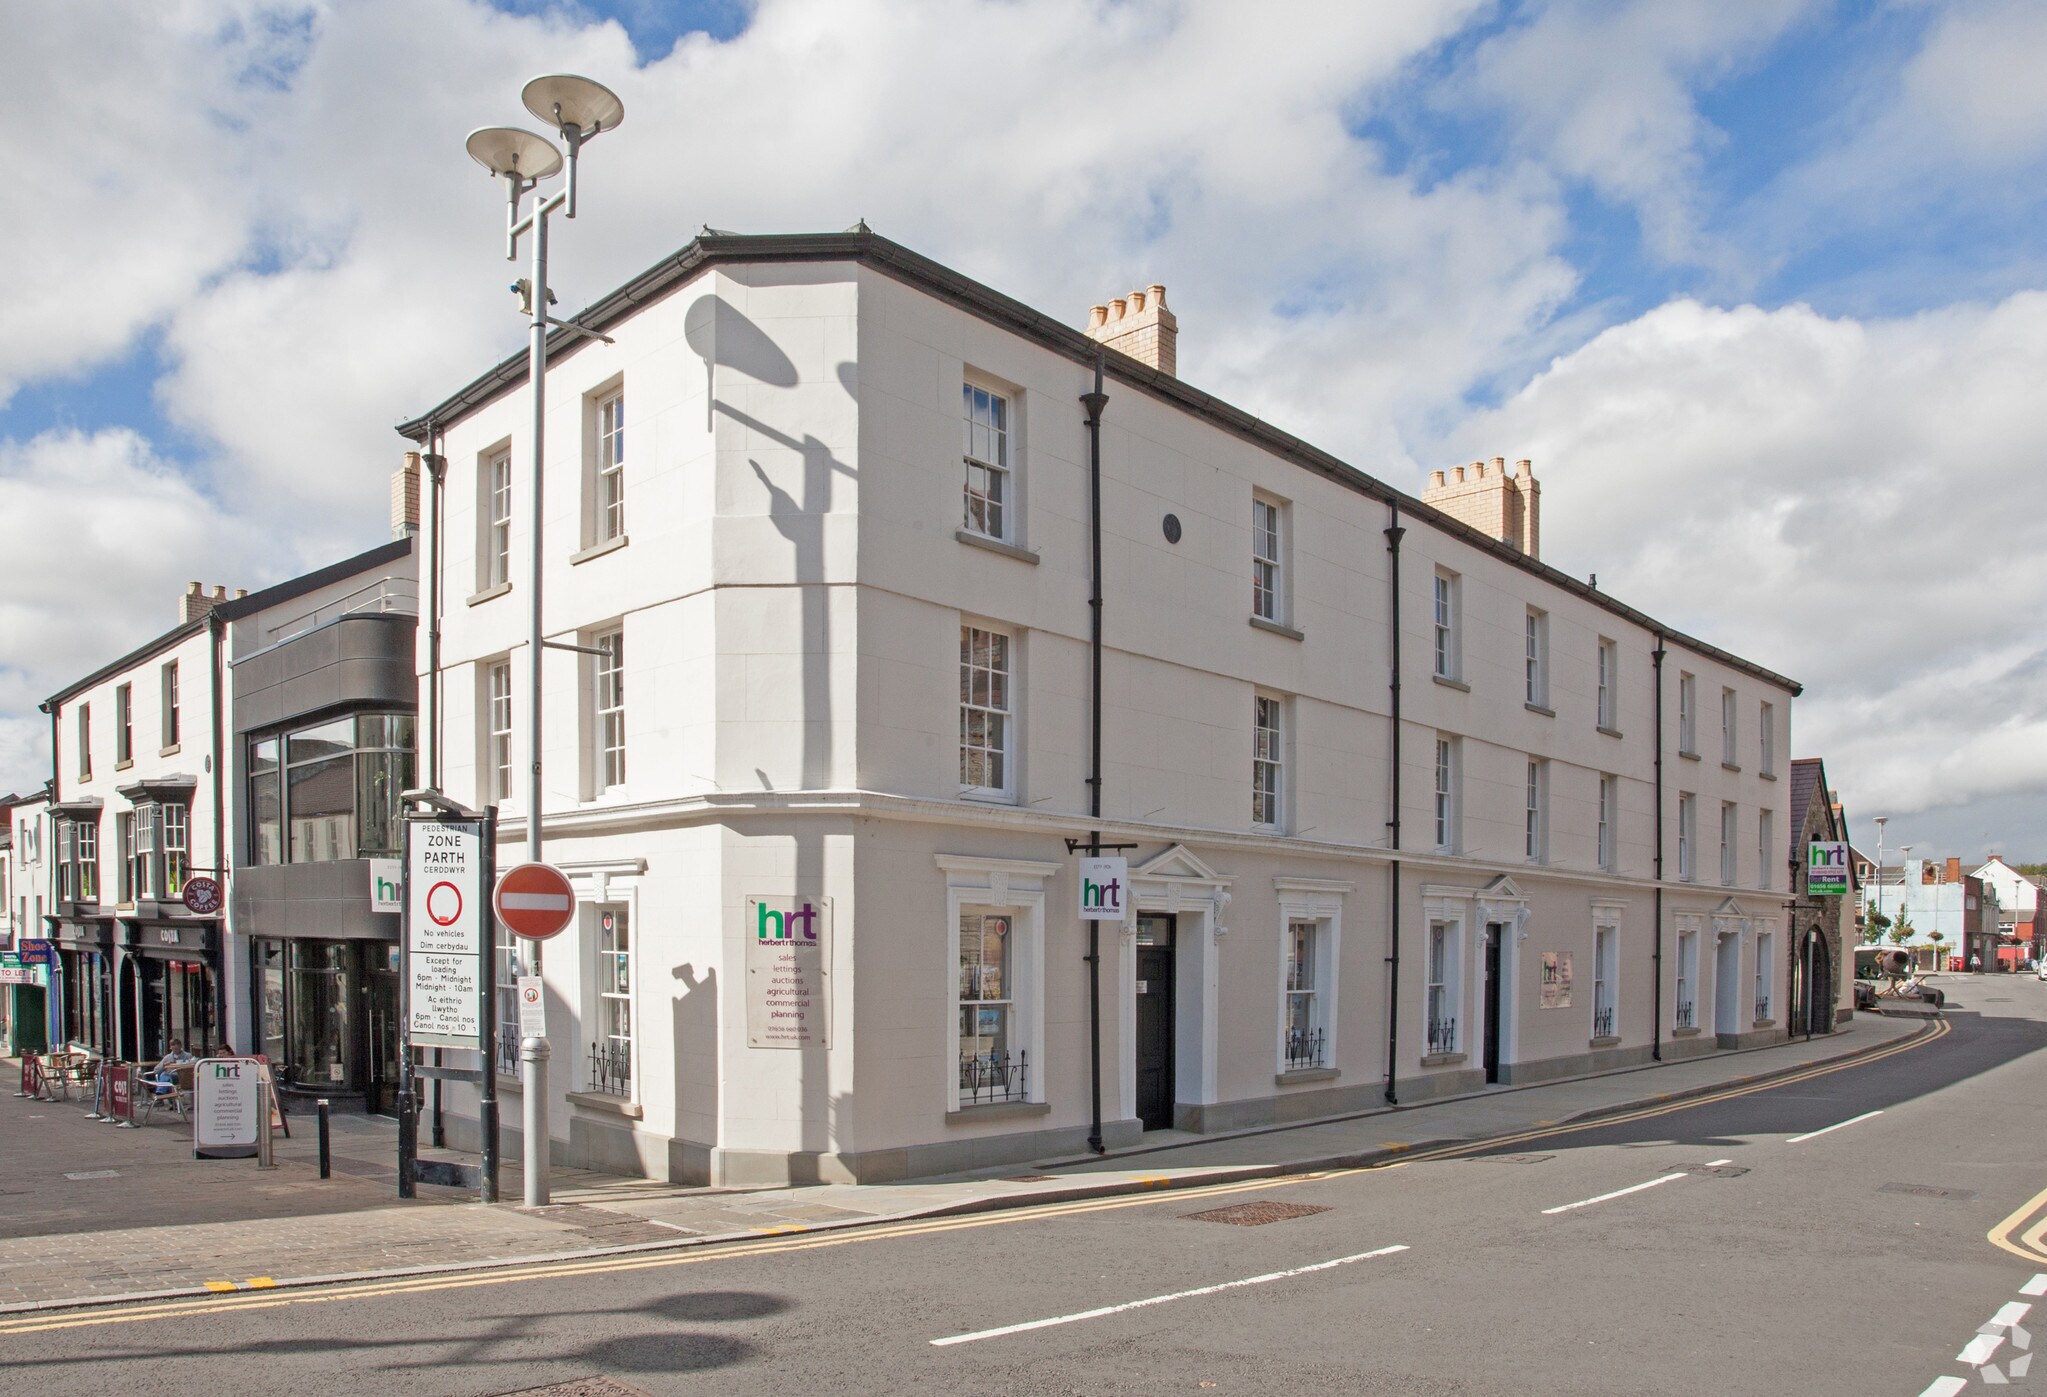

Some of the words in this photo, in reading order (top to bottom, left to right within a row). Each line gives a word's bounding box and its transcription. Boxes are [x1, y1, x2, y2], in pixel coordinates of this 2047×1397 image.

[428, 835, 461, 847] ZONE
[424, 852, 465, 864] PARTH
[1812, 845, 1844, 865] hrt
[424, 866, 465, 874] CERDDWYR
[191, 881, 214, 891] COSTA
[1084, 878, 1120, 907] hrt
[190, 898, 218, 910] COFFEE
[758, 903, 816, 939] hrt
[437, 930, 464, 938] vehicles
[21, 941, 47, 950] Shoe
[436, 942, 468, 951] cerbydau
[789, 939, 816, 947] thomas
[22, 952, 47, 962] Zone
[426, 957, 449, 965] Except
[453, 957, 462, 965] for
[778, 954, 797, 962] sales
[431, 966, 457, 975] loading
[773, 965, 801, 975] lettings
[417, 974, 432, 982] 6pm
[441, 975, 472, 984] Midnight
[771, 977, 804, 985] auctions
[416, 983, 446, 992] Midnight
[454, 985, 473, 993] 10am
[766, 988, 809, 997] agricultural
[440, 996, 462, 1005] eithrio
[766, 999, 809, 1007] commercial
[432, 1005, 458, 1014] llwytho
[415, 1012, 431, 1021] 6pm
[440, 1014, 460, 1022] Canol
[771, 1010, 805, 1020] planning
[414, 1021, 434, 1029] Canol
[216, 1064, 240, 1077] hrt
